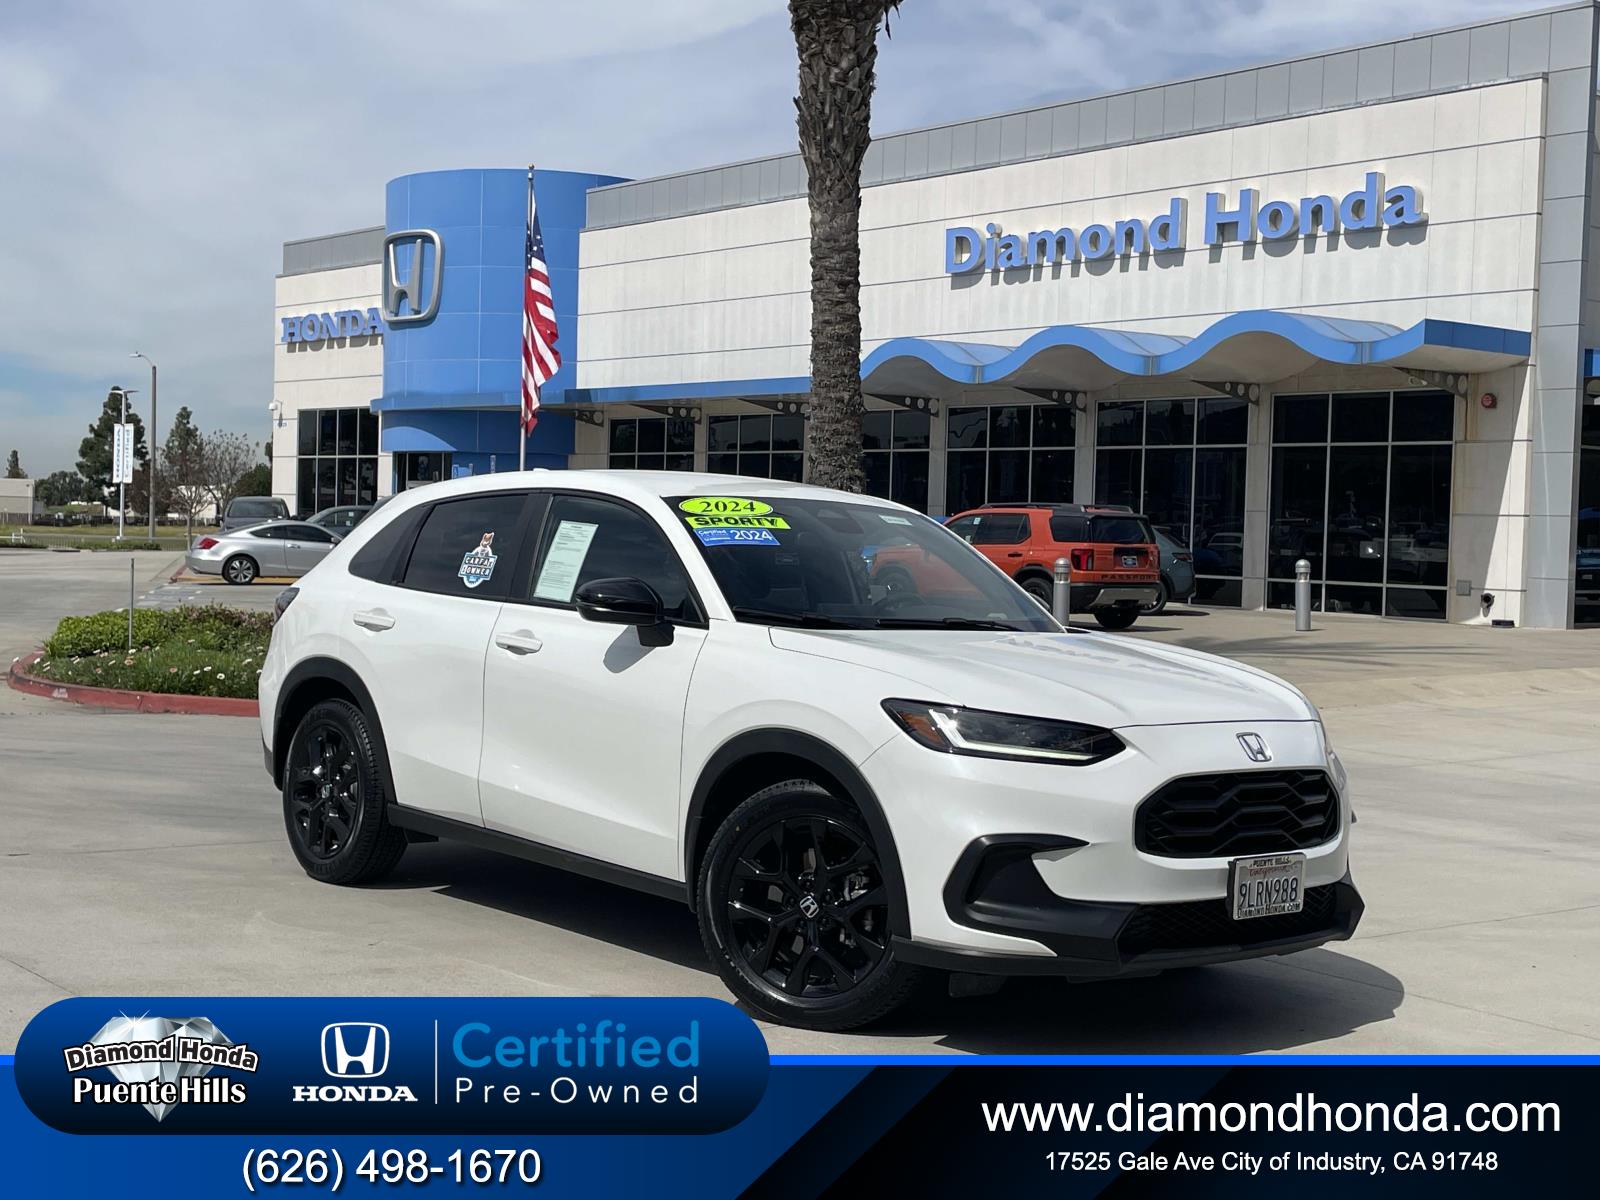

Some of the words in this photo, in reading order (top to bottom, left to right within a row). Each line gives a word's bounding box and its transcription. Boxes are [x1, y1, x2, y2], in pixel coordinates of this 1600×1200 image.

[945, 197, 1187, 275] Diamond
[1204, 171, 1427, 246] Honda
[281, 307, 383, 343] HONDA
[699, 501, 756, 513] 2024
[694, 516, 778, 527] SPORTY
[730, 530, 772, 540] 2024
[465, 556, 494, 567] CARFAX
[1240, 877, 1298, 907] 9LRN988
